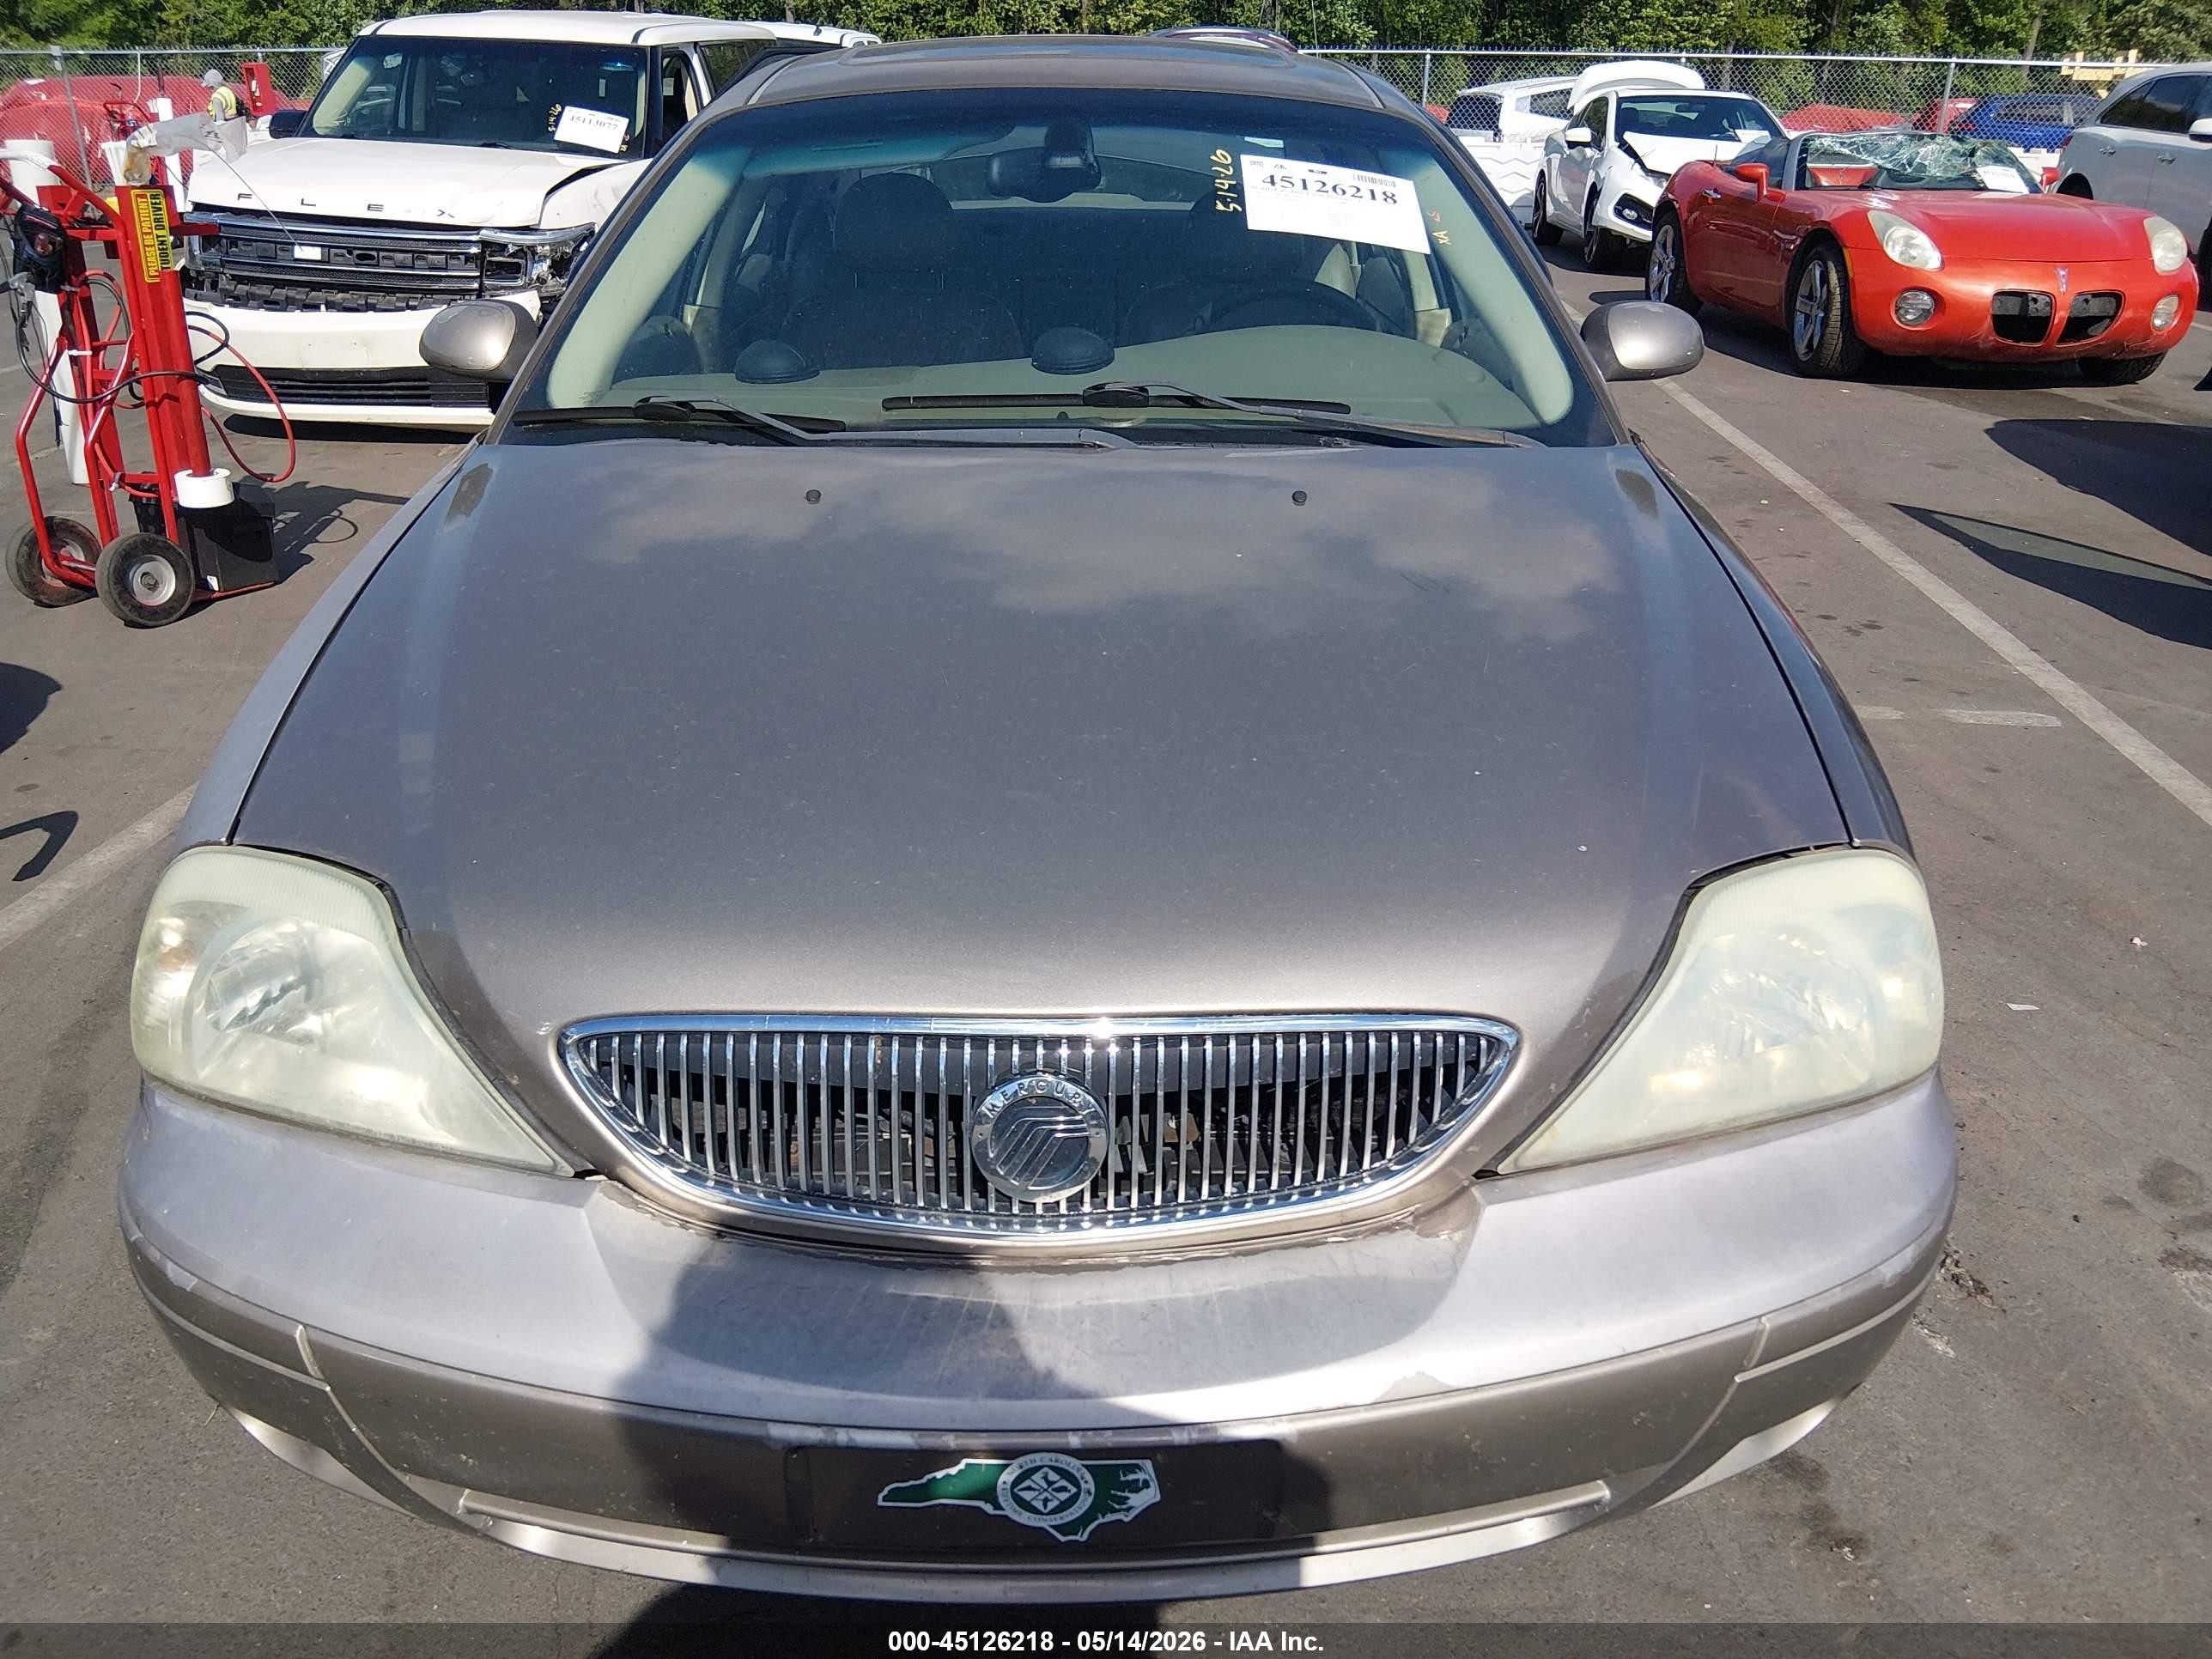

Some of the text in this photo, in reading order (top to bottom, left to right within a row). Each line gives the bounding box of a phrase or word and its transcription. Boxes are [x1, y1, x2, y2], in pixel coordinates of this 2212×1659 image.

[237, 192, 456, 219] FLEX
[1261, 173, 1398, 206] 45126218
[137, 198, 160, 276] PLEASE BE PATIENT
[150, 192, 172, 270] TUDENT DRIVER
[981, 1079, 1096, 1119] MERCURY
